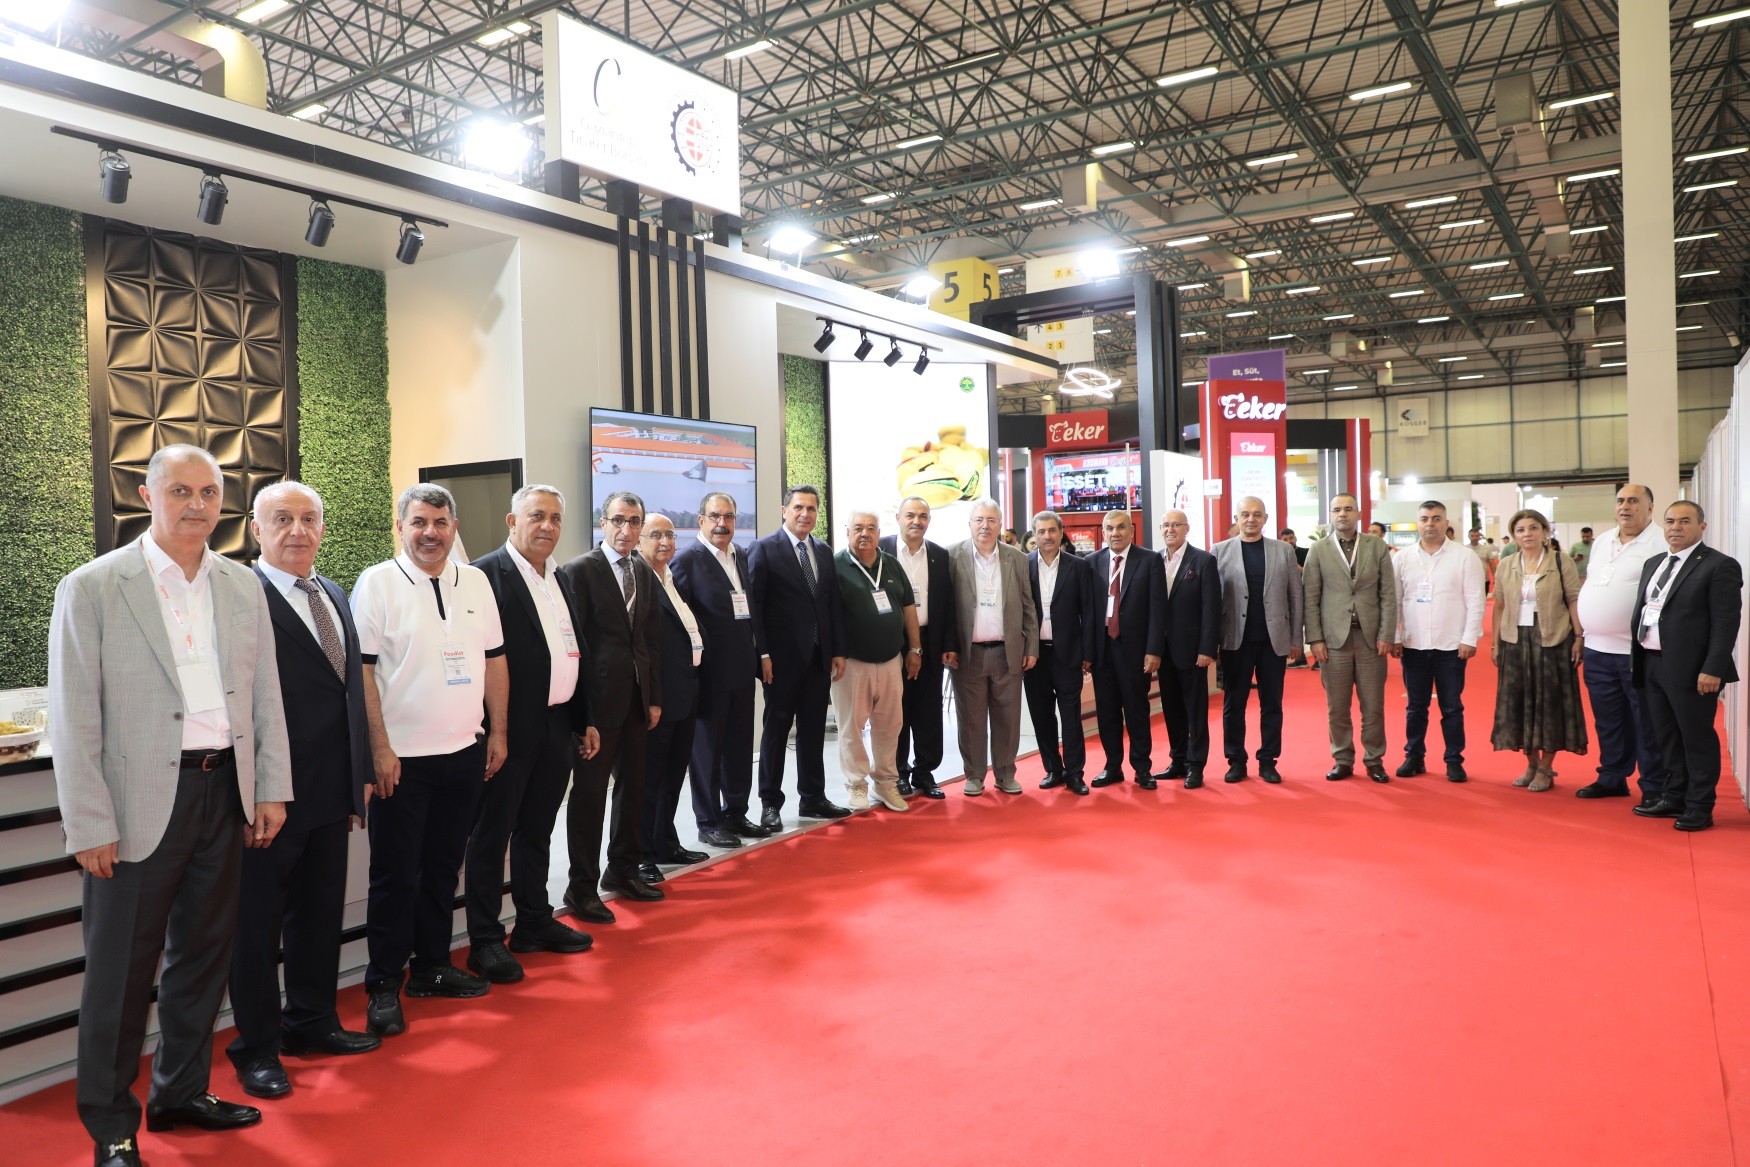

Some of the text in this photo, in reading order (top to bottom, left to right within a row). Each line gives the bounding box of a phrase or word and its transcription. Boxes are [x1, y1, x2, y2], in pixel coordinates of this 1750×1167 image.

[944, 271, 960, 303] 5
[983, 272, 992, 301] 5
[1244, 367, 1260, 375] Süt,
